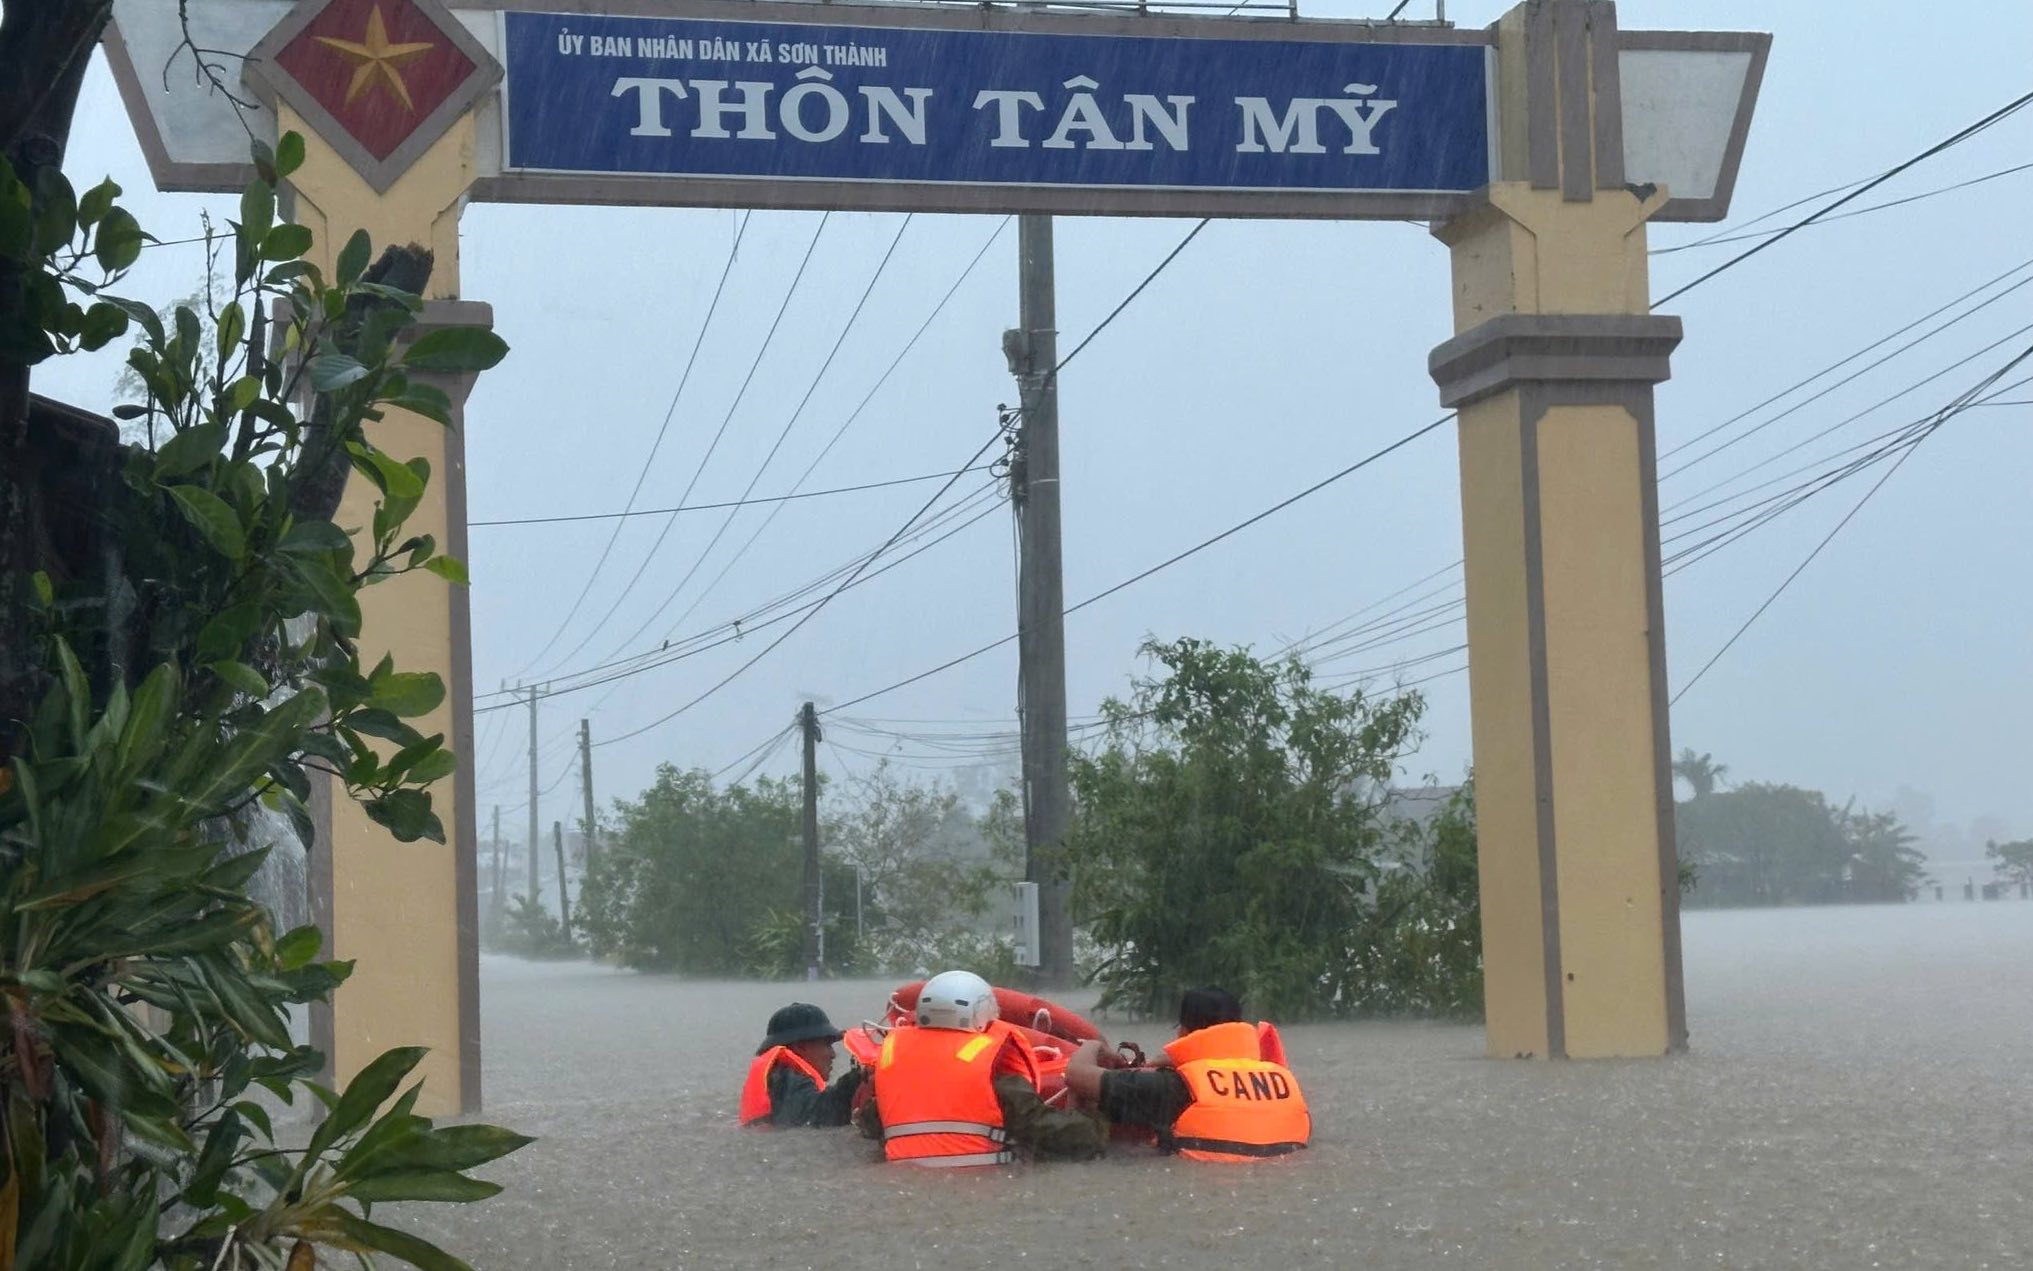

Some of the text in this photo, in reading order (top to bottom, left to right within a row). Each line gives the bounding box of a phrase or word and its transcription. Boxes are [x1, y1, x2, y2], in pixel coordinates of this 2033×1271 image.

[558, 28, 887, 67] ỦY BAN NHÂN DÂN XÃ SƠN THÀNH
[610, 65, 1398, 155] THÔN TÂN MỸ
[1206, 1069, 1290, 1101] CAND
